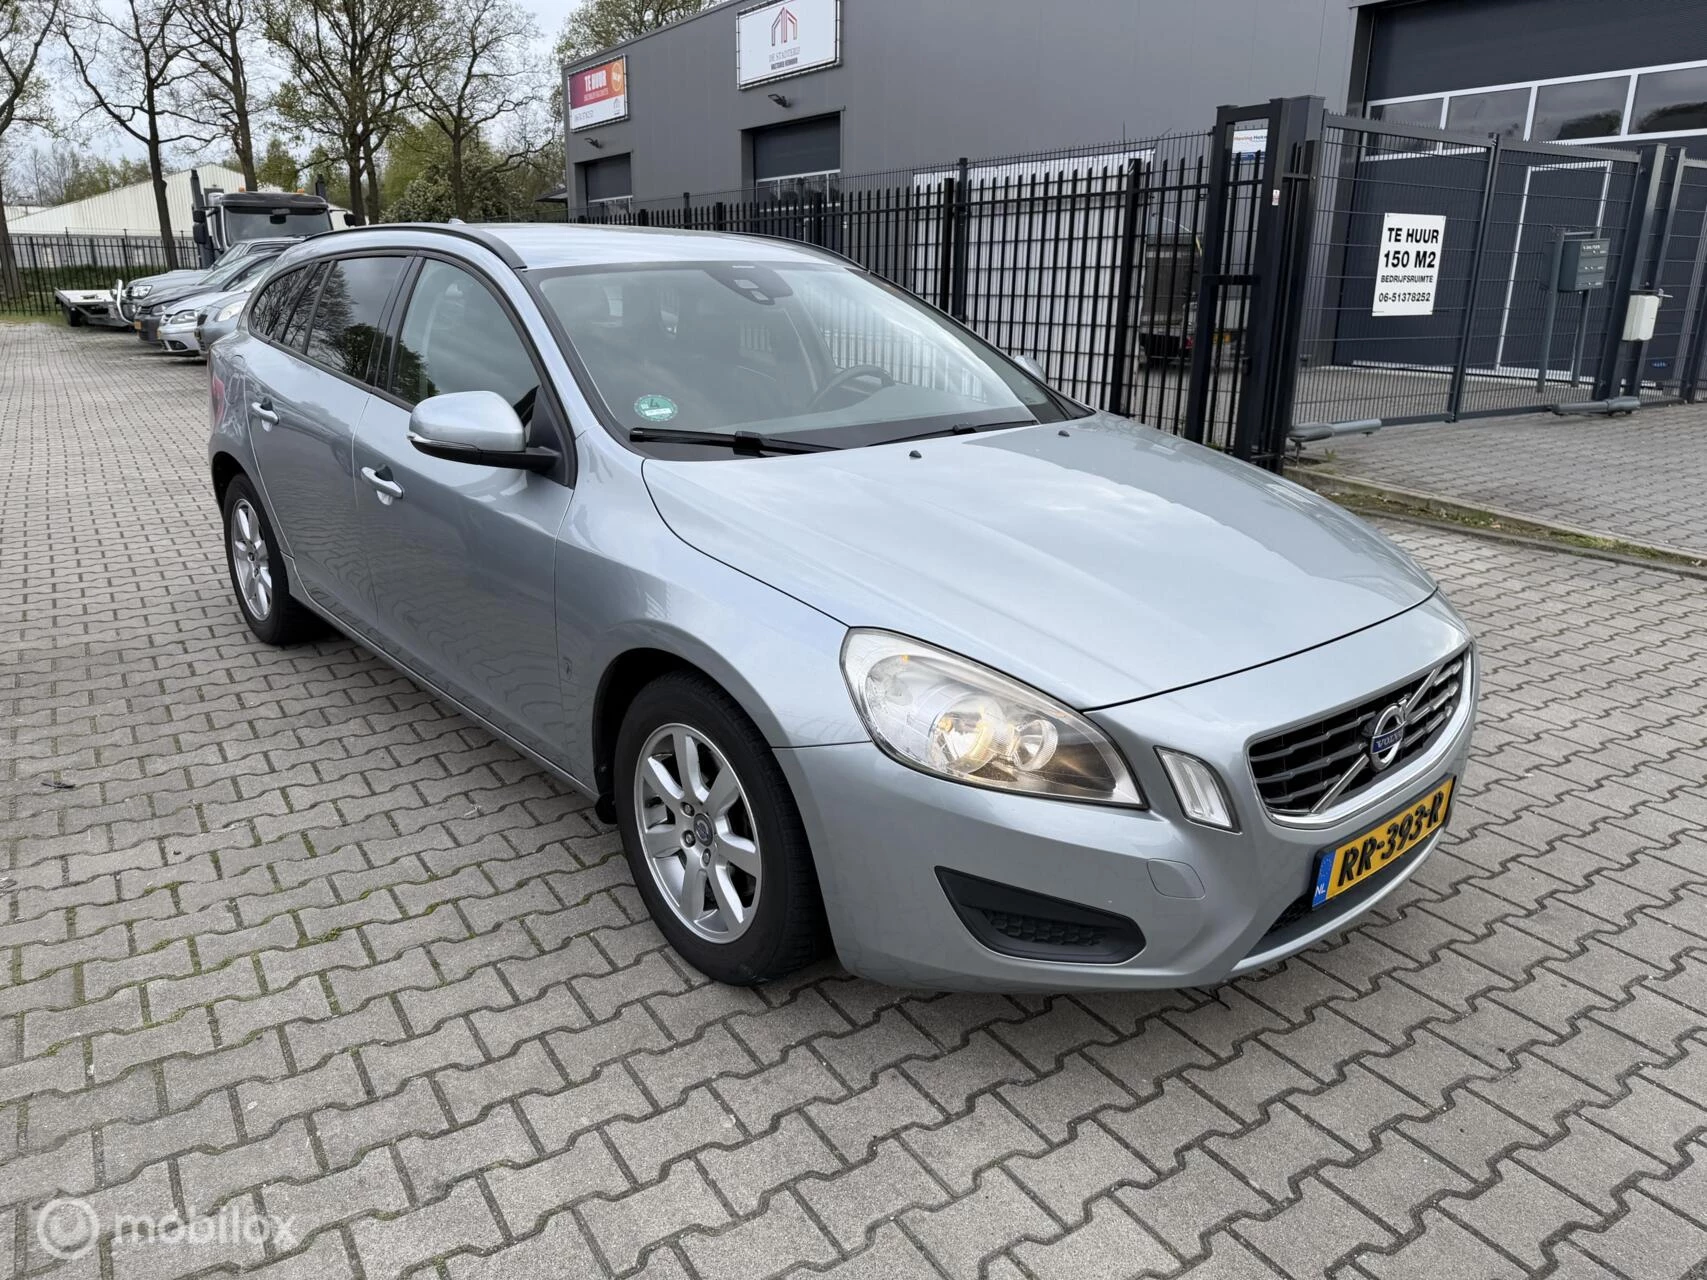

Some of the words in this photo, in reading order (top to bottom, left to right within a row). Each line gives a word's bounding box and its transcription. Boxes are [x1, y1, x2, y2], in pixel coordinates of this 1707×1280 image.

[1387, 227, 1403, 243] TE
[1405, 228, 1440, 244] HUUR
[1383, 250, 1410, 268] 150
[1414, 250, 1436, 268] M2
[1380, 274, 1434, 283] BEDRIJFSRUIMTE
[1378, 292, 1431, 302] 06-51378252
[1337, 790, 1444, 887] RR-393-R
[1314, 882, 1326, 897] NL
